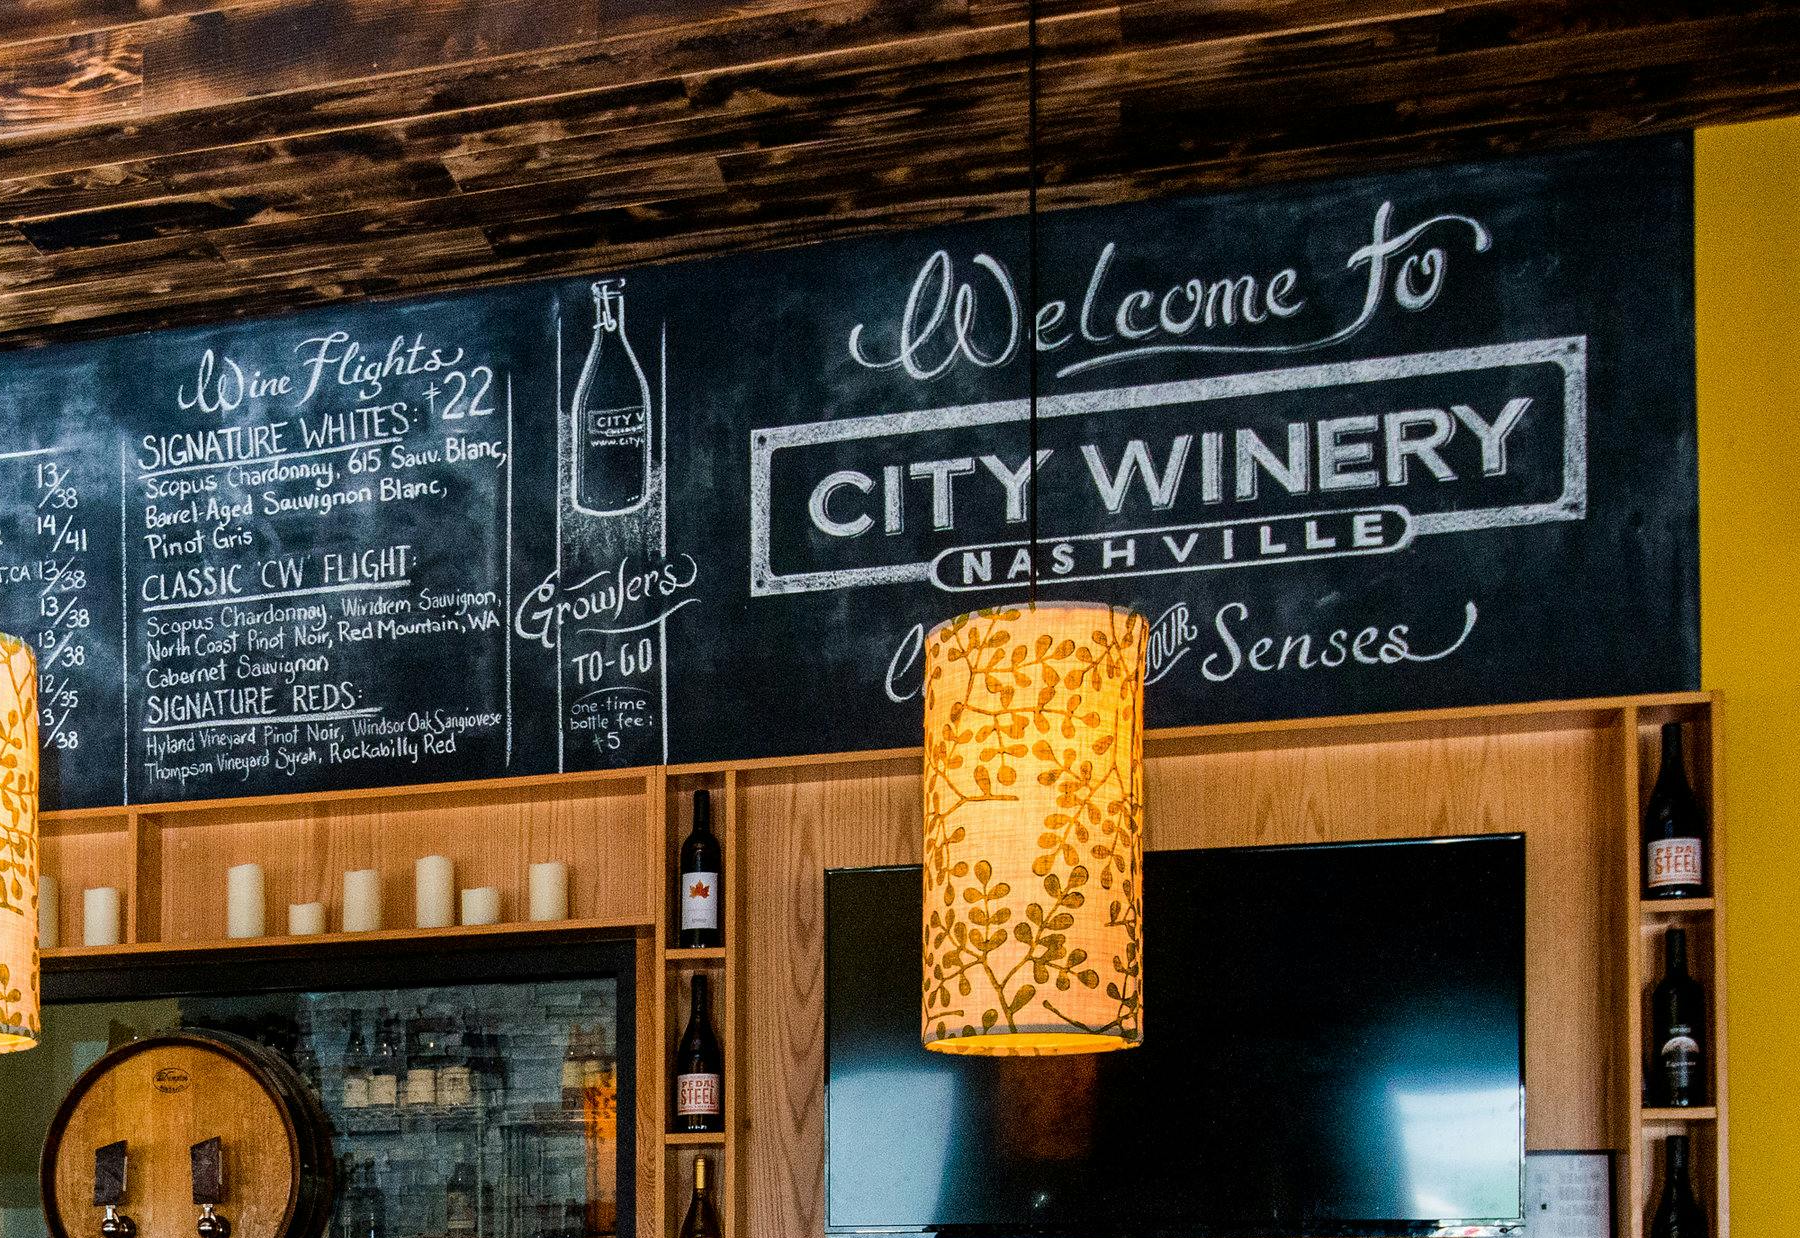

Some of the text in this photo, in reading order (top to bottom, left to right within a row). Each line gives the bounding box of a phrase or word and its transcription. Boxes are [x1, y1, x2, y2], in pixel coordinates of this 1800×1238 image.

[849, 242, 1307, 381] Welcome
[178, 349, 292, 413] Wine
[295, 331, 463, 407] Flights
[597, 414, 632, 428] CITY
[139, 421, 288, 469] SIGNATURE
[808, 397, 1534, 541] CITY WINERY
[264, 485, 370, 515] Sauvignon
[144, 527, 253, 559] Pinot Gris
[961, 505, 1384, 585] NASHVILLE
[142, 564, 243, 600] CLASSIC
[515, 554, 698, 648] Growlers
[572, 638, 653, 683] TO-GO
[1202, 600, 1478, 683] Senses
[148, 686, 274, 724] SIGNATURE
[681, 1088, 715, 1105] STEEL
